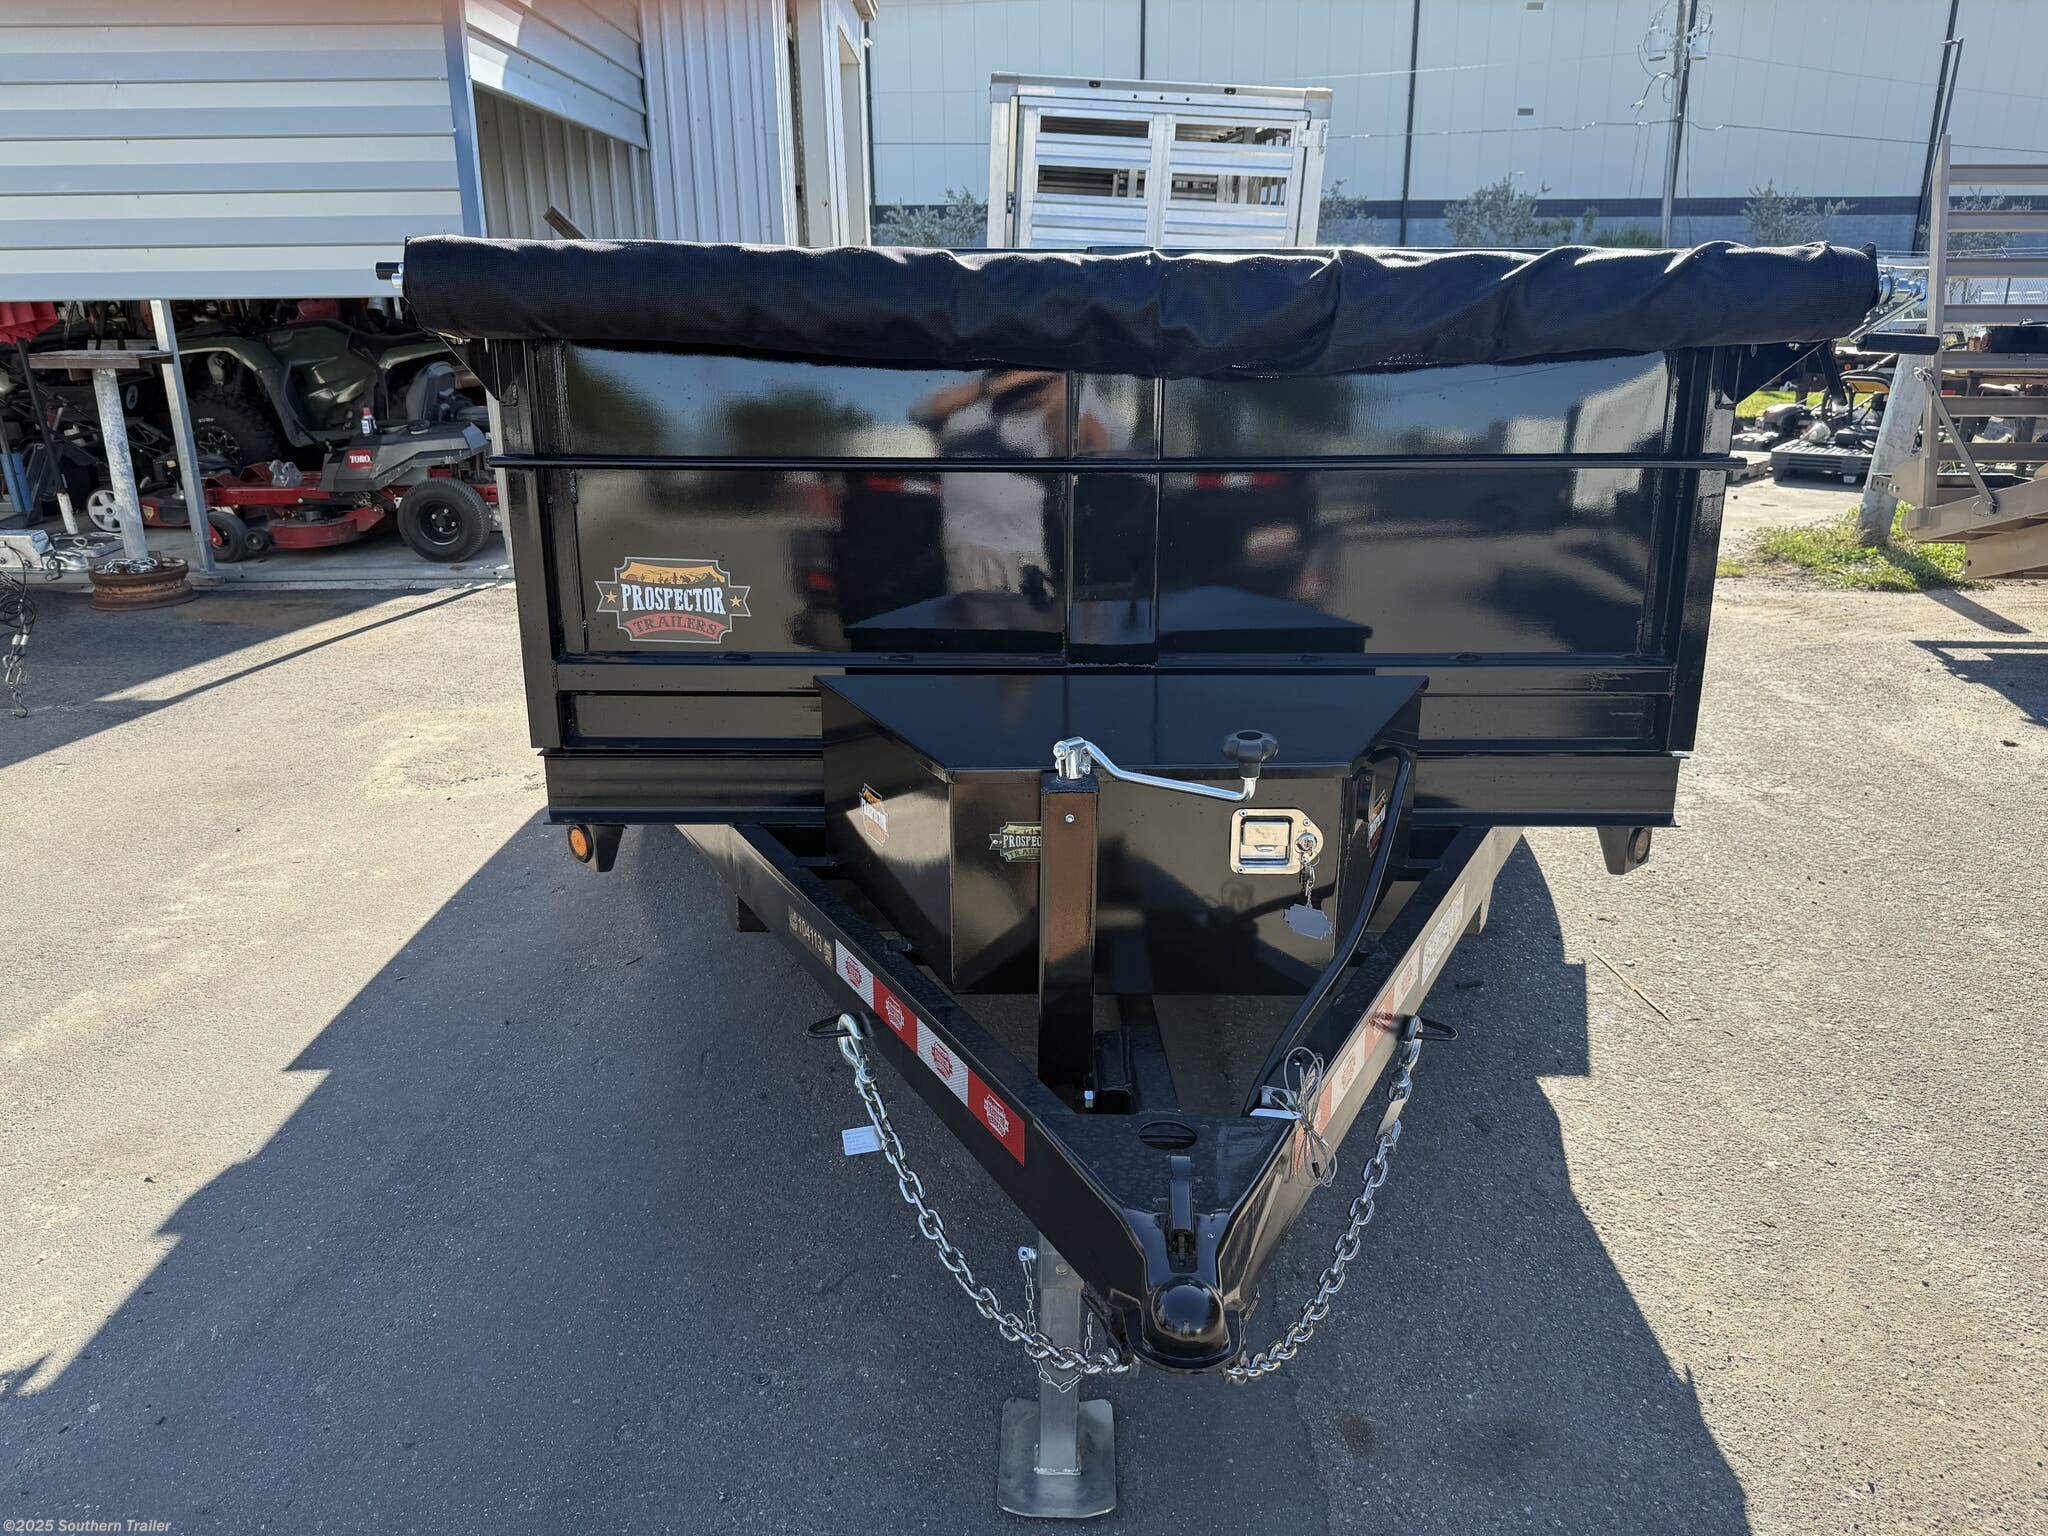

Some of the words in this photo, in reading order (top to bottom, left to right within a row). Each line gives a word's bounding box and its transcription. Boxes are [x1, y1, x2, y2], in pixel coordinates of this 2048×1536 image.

[349, 455, 370, 463] TORO
[621, 583, 726, 615] PROSPECTOR
[633, 616, 718, 636] TRAILERS
[1003, 834, 1041, 848] PROSPEC
[1008, 848, 1040, 858] TRAIL
[798, 917, 823, 952] 104113
